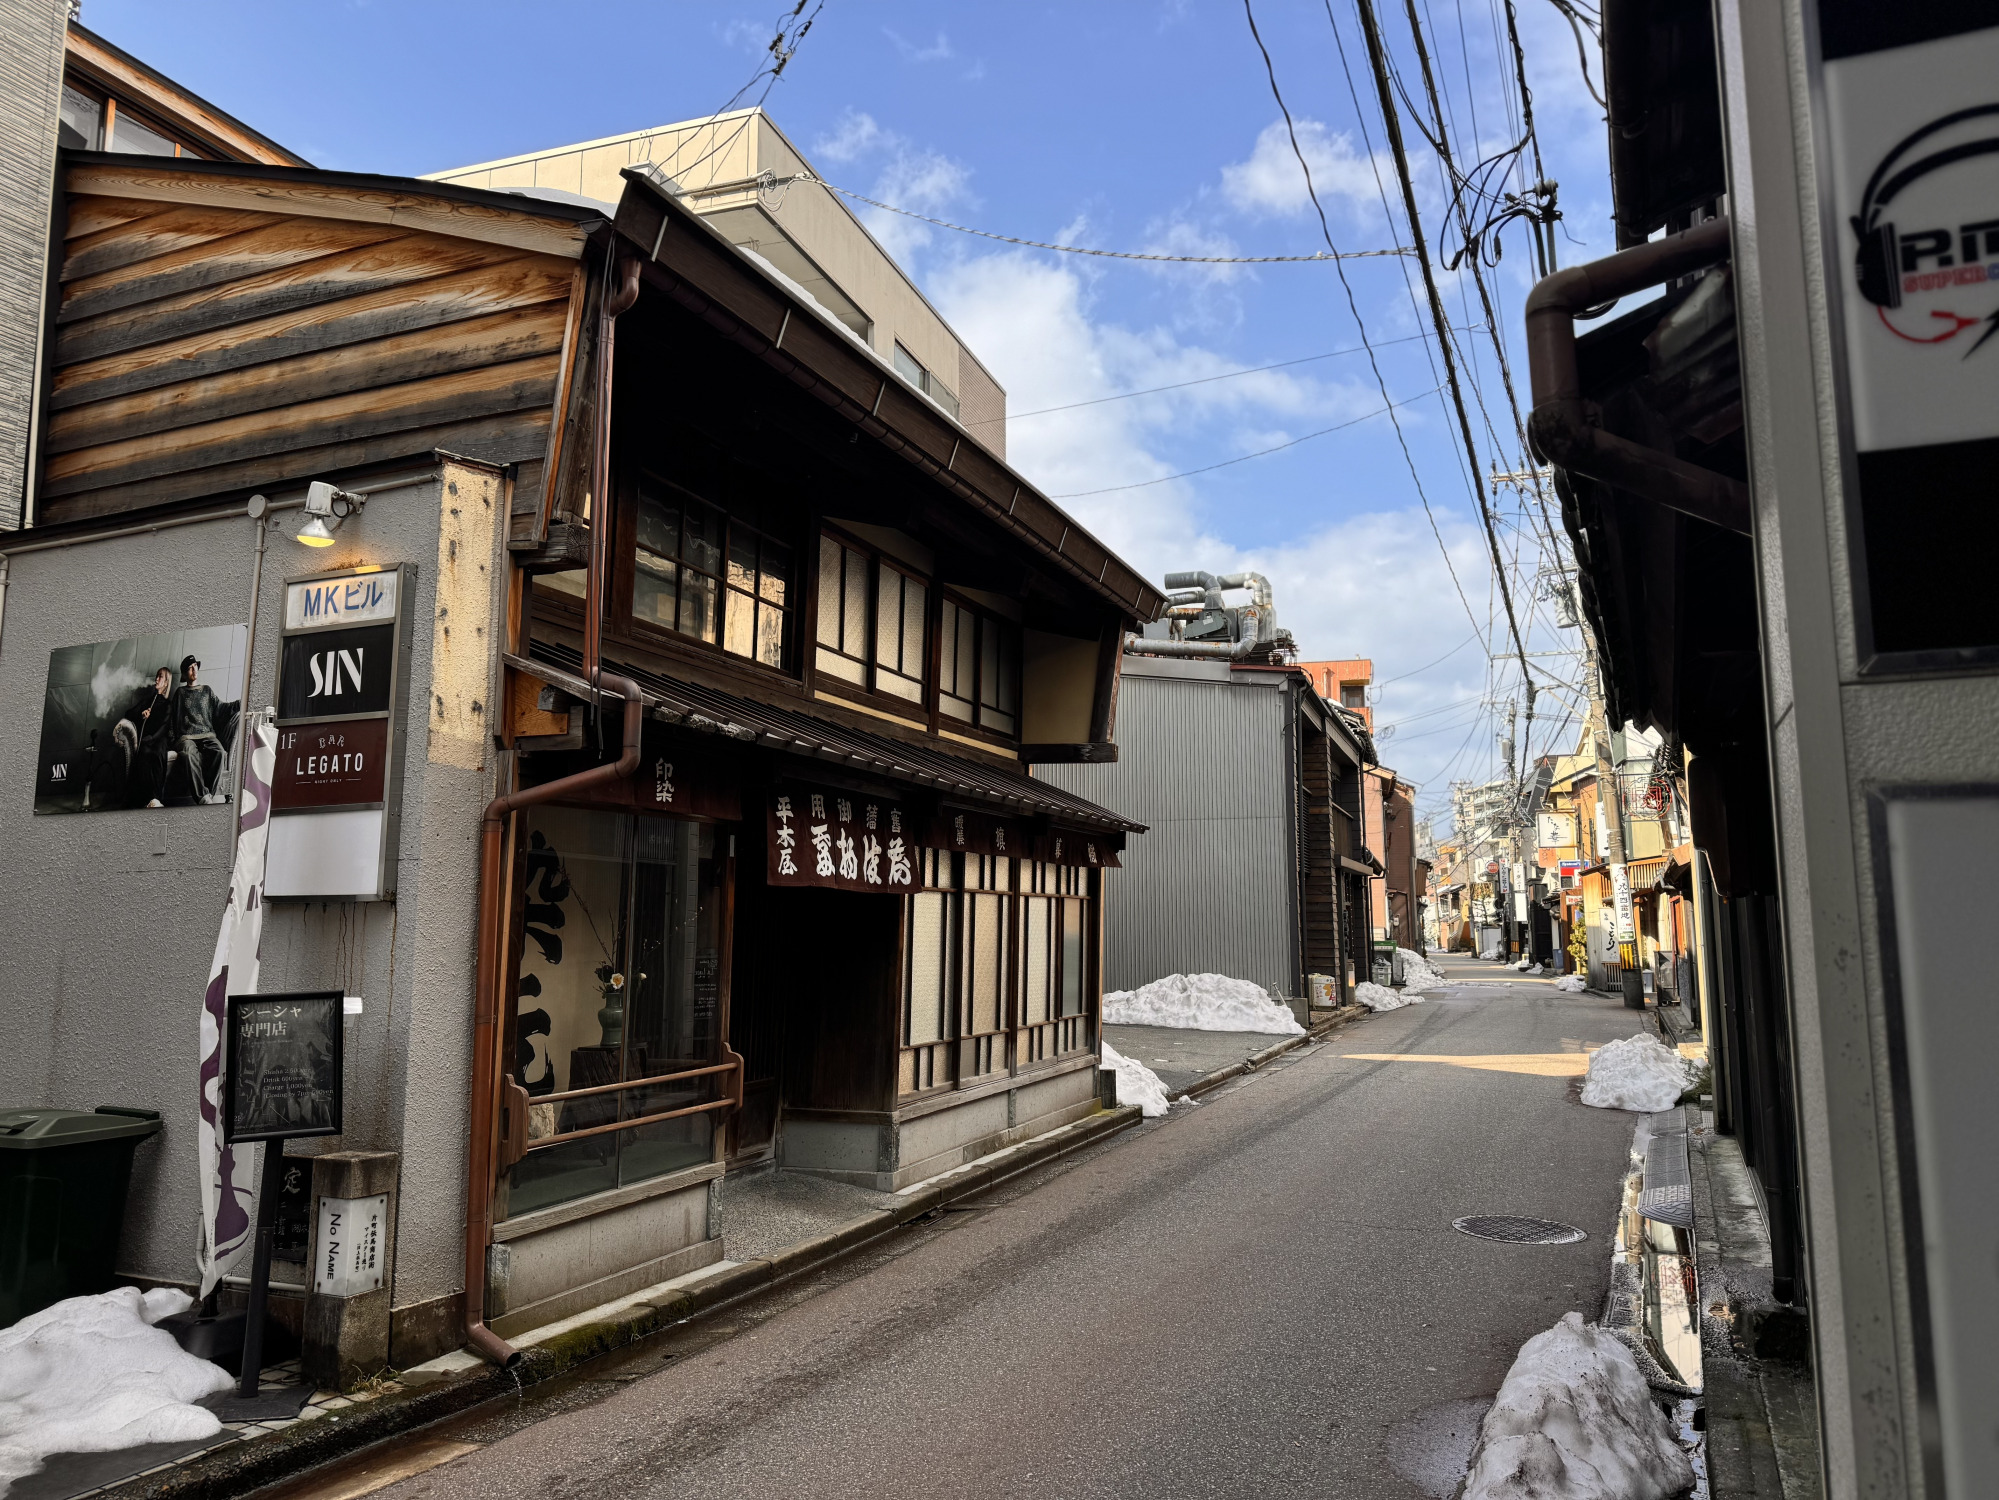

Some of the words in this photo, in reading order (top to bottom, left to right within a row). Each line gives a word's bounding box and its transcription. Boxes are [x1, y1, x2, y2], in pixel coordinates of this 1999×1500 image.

[307, 648, 364, 698] SIN
[280, 733, 297, 750] 1F
[318, 734, 345, 749] BAR
[51, 763, 68, 779] SIN
[296, 752, 364, 775] LEGATO
[655, 757, 675, 803] 印染
[776, 796, 798, 876] 平木屋
[241, 1005, 302, 1020] シーシャ
[240, 1021, 288, 1038] 専門店
